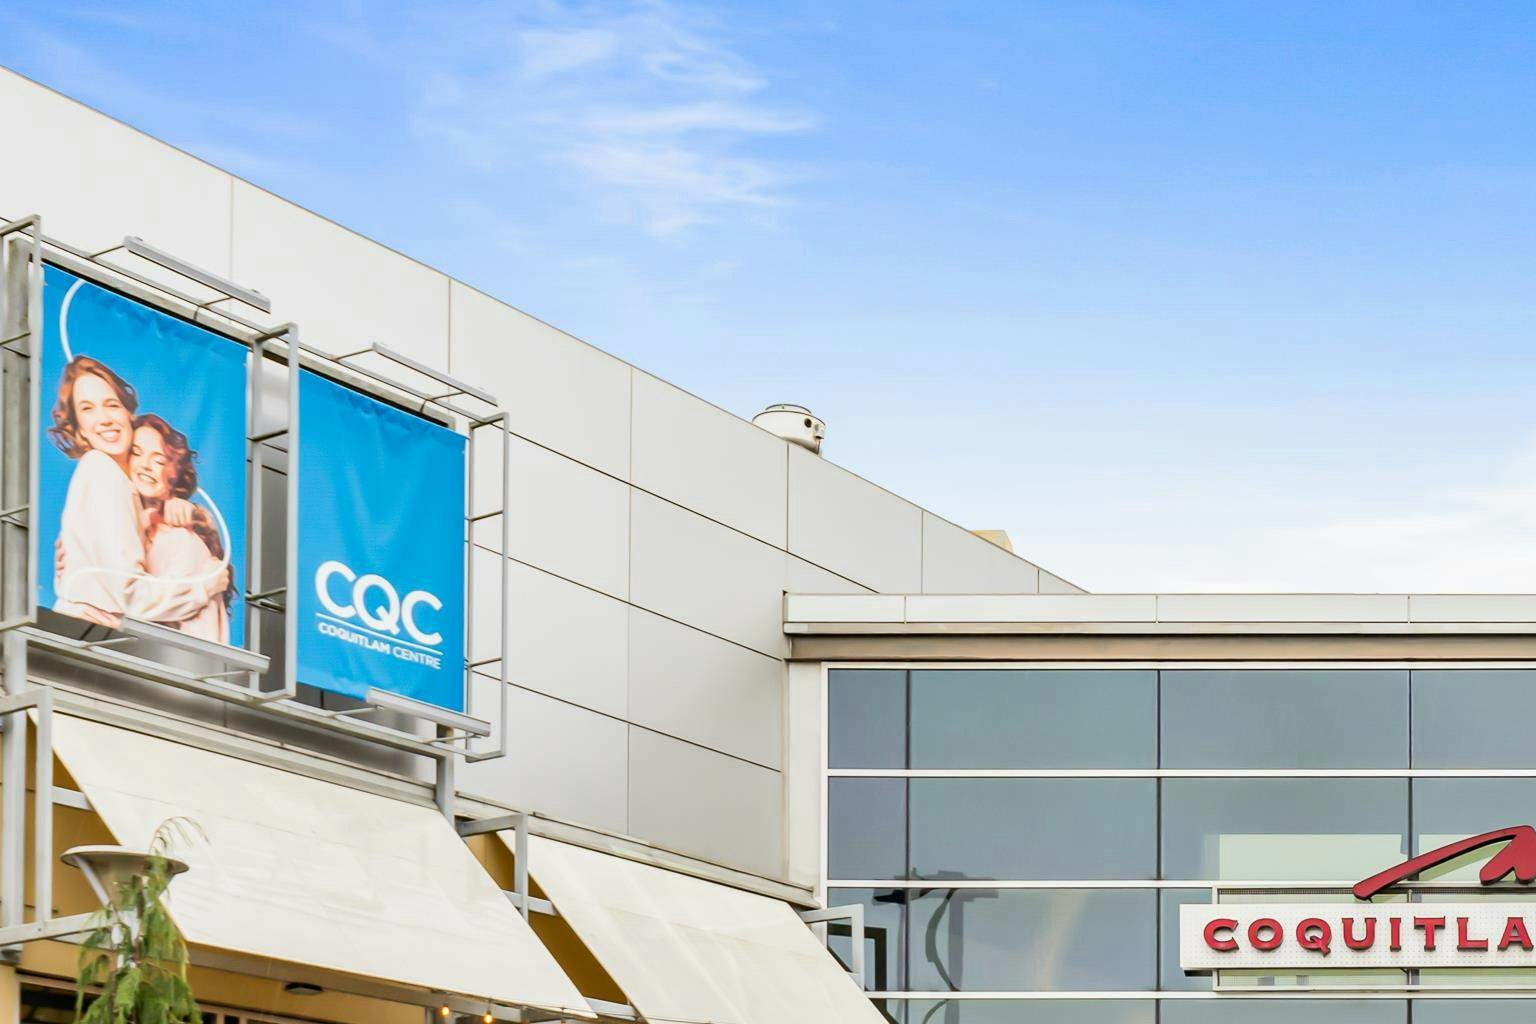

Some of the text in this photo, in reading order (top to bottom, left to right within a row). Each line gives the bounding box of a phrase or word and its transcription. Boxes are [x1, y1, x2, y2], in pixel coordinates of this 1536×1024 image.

[314, 560, 443, 645] CQC
[318, 622, 441, 670] COQUITLAM CENTRE
